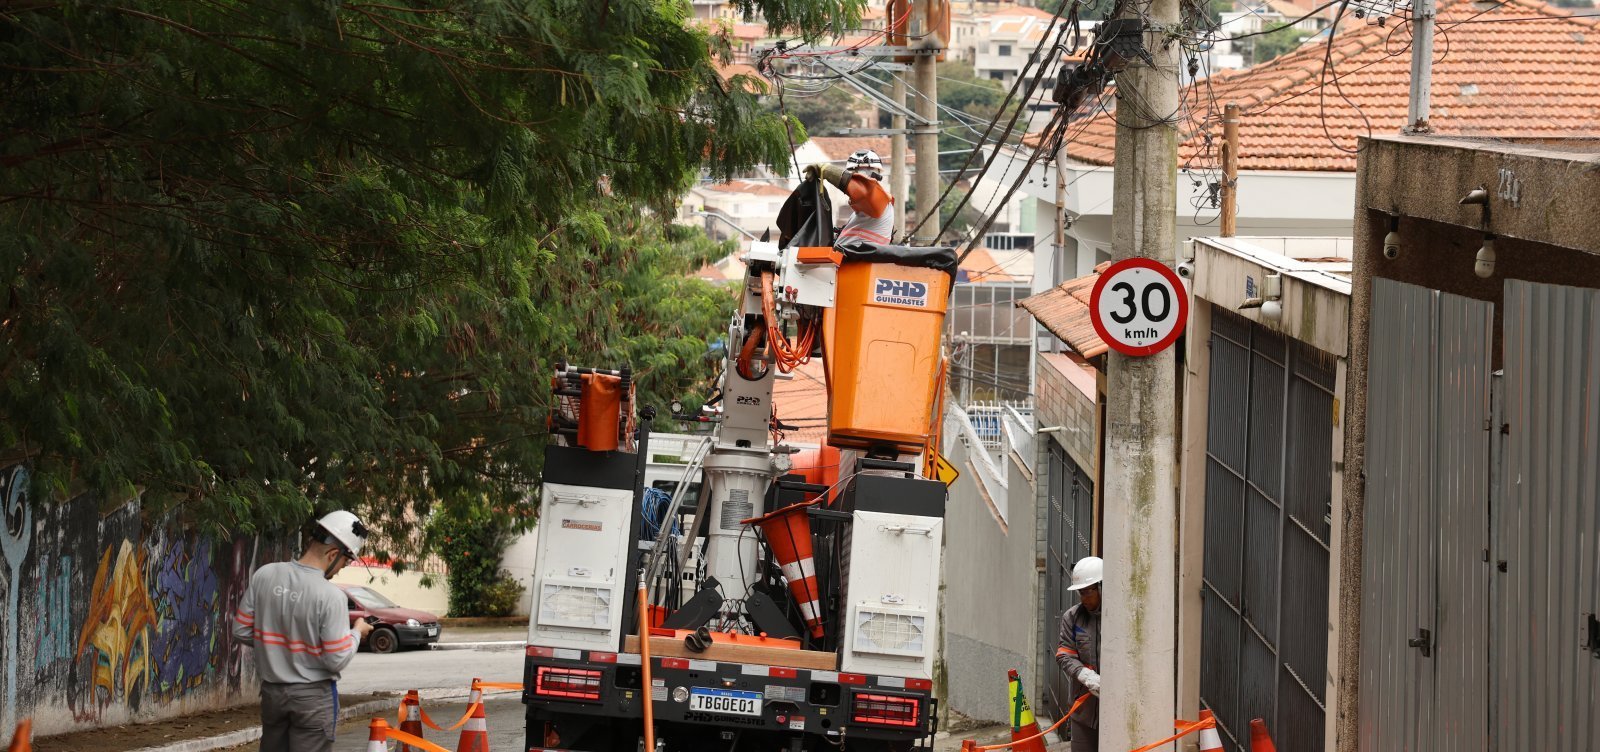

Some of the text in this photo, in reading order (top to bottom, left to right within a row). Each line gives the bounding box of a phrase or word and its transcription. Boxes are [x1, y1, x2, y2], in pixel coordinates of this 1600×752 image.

[876, 279, 926, 297] PHD
[876, 296, 925, 306] GUINDASTES
[1110, 282, 1171, 324] 30
[1125, 328, 1158, 339] km/h
[684, 711, 766, 726] PHD GUINDASTES
